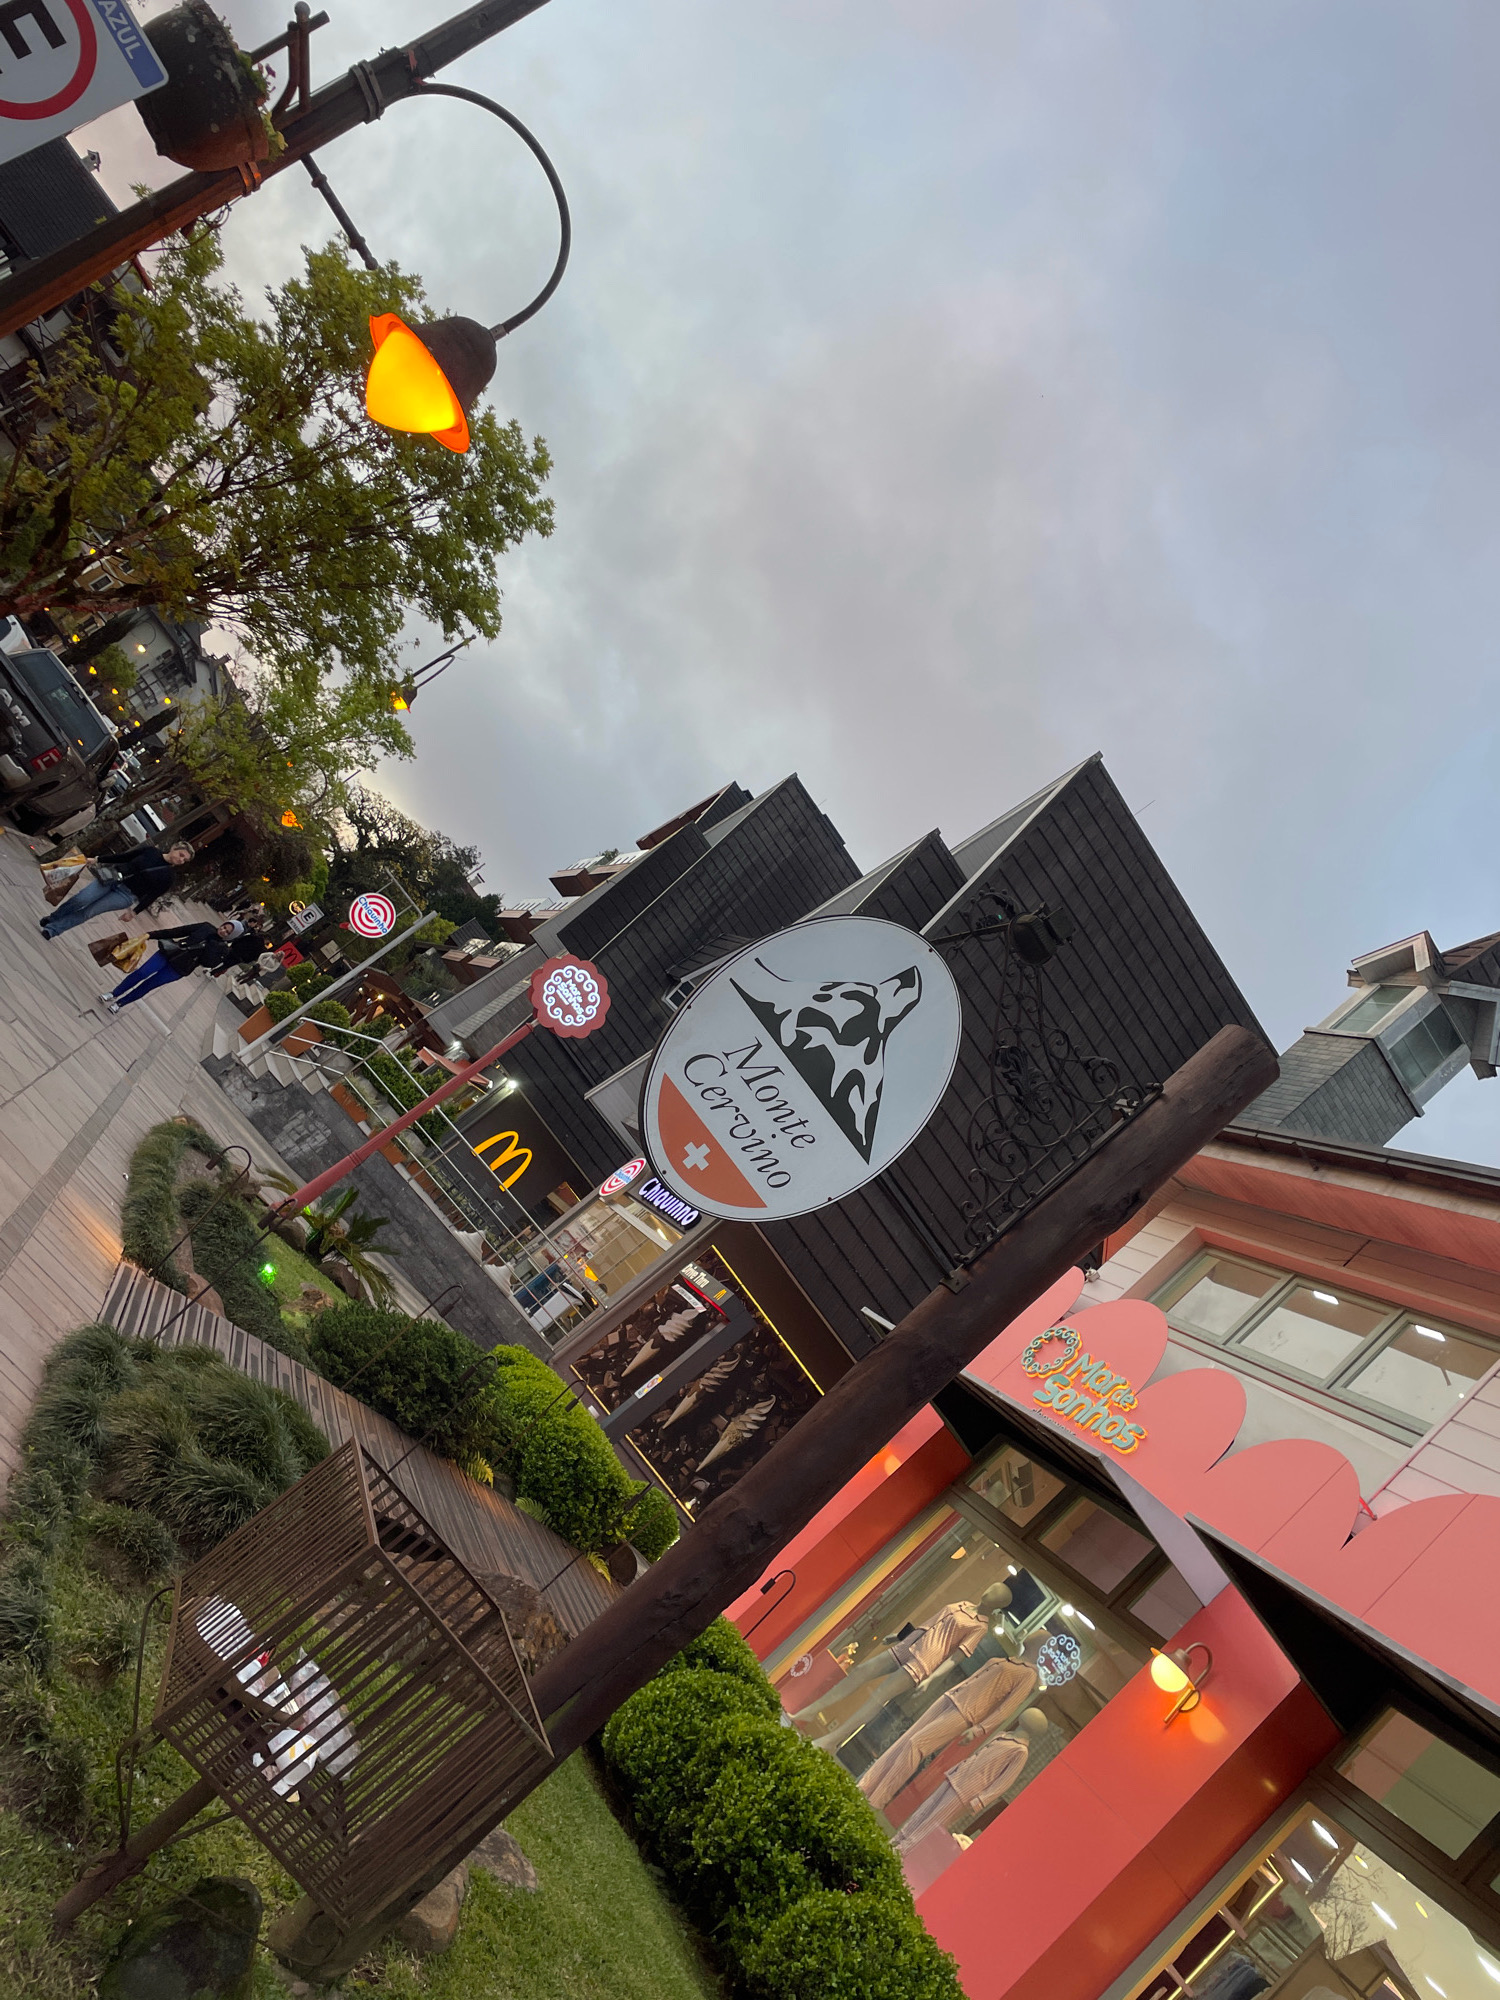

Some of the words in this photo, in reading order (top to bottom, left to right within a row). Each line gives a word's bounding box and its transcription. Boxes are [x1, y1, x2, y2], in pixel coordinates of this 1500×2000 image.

[98, 1, 142, 60] AZUL
[303, 911, 315, 922] E
[358, 896, 388, 934] Chiquinho
[557, 981, 584, 1015] Sonhos
[565, 978, 581, 996] Mar
[722, 1036, 816, 1149] Monte
[684, 1053, 792, 1189] Cervino
[681, 1263, 699, 1280] Drive
[693, 1272, 710, 1288] Thru
[1066, 1353, 1128, 1397] Mar
[1112, 1388, 1136, 1410] de
[1033, 1373, 1147, 1451] Sonhos
